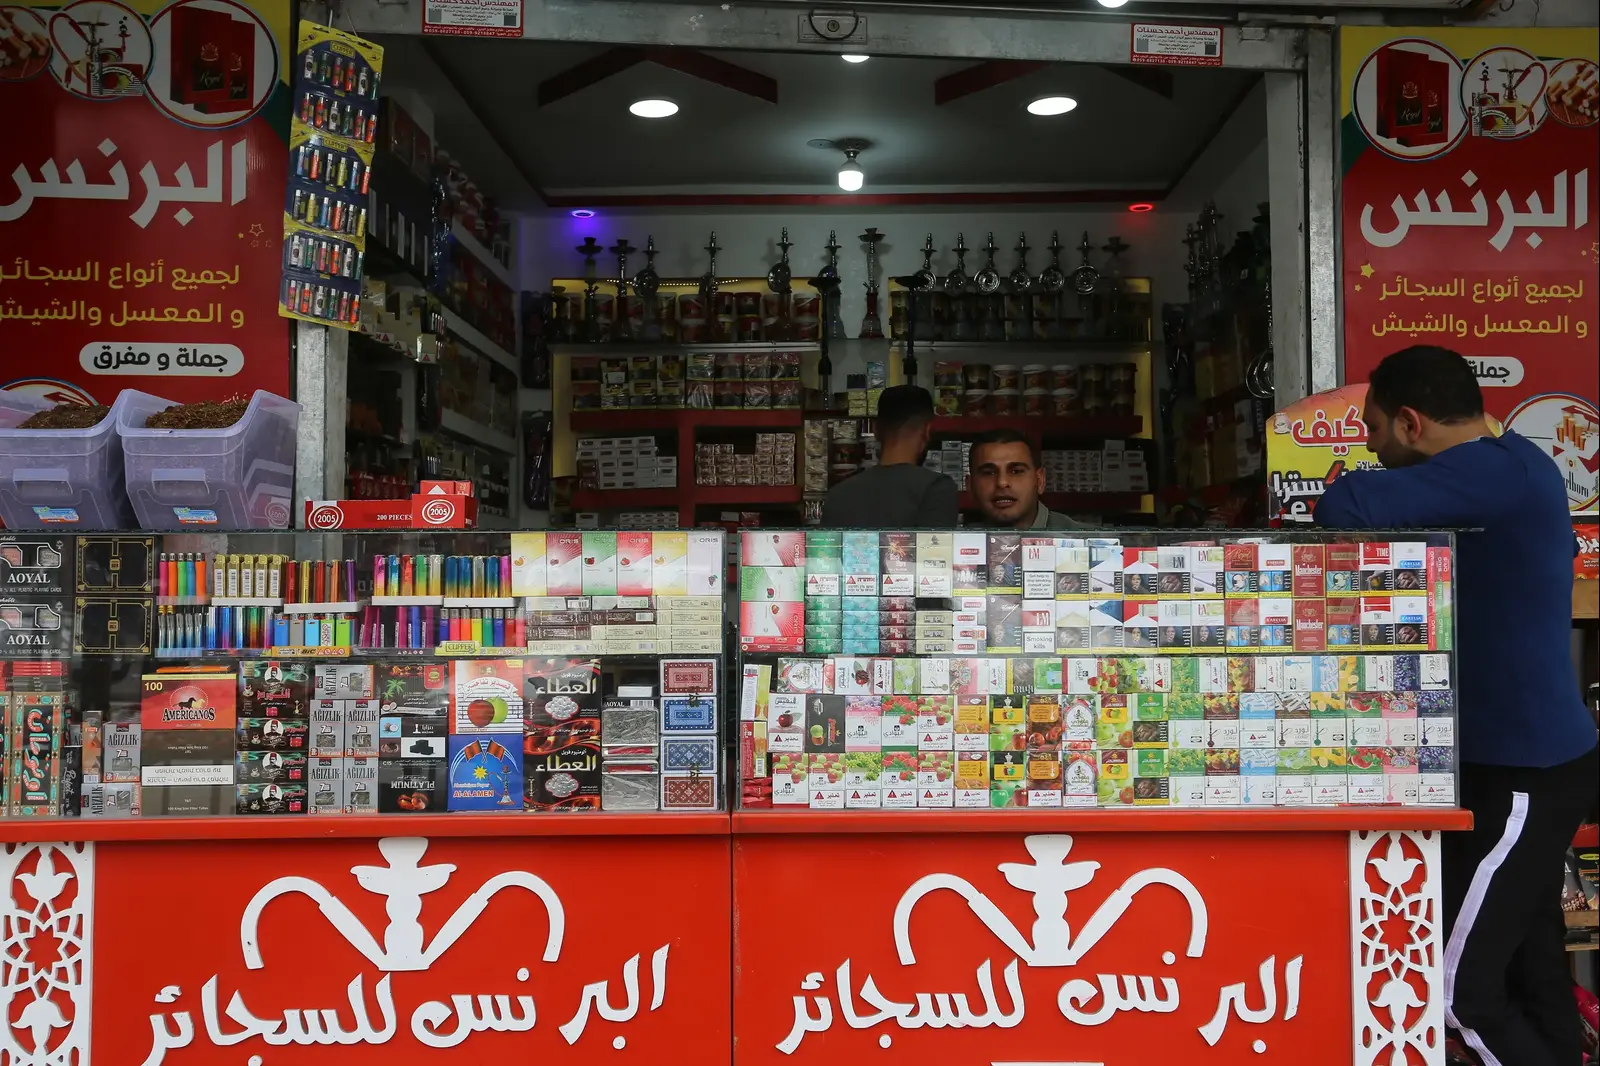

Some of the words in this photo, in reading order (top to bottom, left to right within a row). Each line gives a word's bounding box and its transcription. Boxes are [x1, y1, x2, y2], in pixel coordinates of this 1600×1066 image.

[0, 138, 247, 229] البرنس
[1360, 167, 1588, 252] البرنس
[0, 256, 99, 286] السجائ
[109, 258, 164, 289] أنواع
[171, 264, 240, 290] لجميع
[1379, 275, 1465, 302] السجائر
[1472, 275, 1520, 304] أنواع
[1525, 279, 1584, 304] لجميع
[109, 300, 222, 327] المعسل
[230, 307, 245, 329] و
[1372, 311, 1468, 338] والشيش
[1473, 313, 1569, 338] المعسل
[1576, 320, 1588, 339] و
[93, 344, 151, 370] مفرق
[157, 353, 170, 371] و
[175, 347, 229, 373] جملة
[316, 514, 336, 523] 2005
[430, 507, 447, 516] 2005
[1376, 547, 1389, 557] TIME
[7, 572, 51, 584] AOYAL
[6, 634, 50, 646] AOYAL
[144, 682, 163, 691] 100
[535, 677, 597, 695] العطاء
[535, 754, 597, 772] العطاء
[390, 780, 435, 789] PLATINUM
[775, 956, 1026, 1055] للسجائر
[140, 972, 398, 1066] للسجائر
